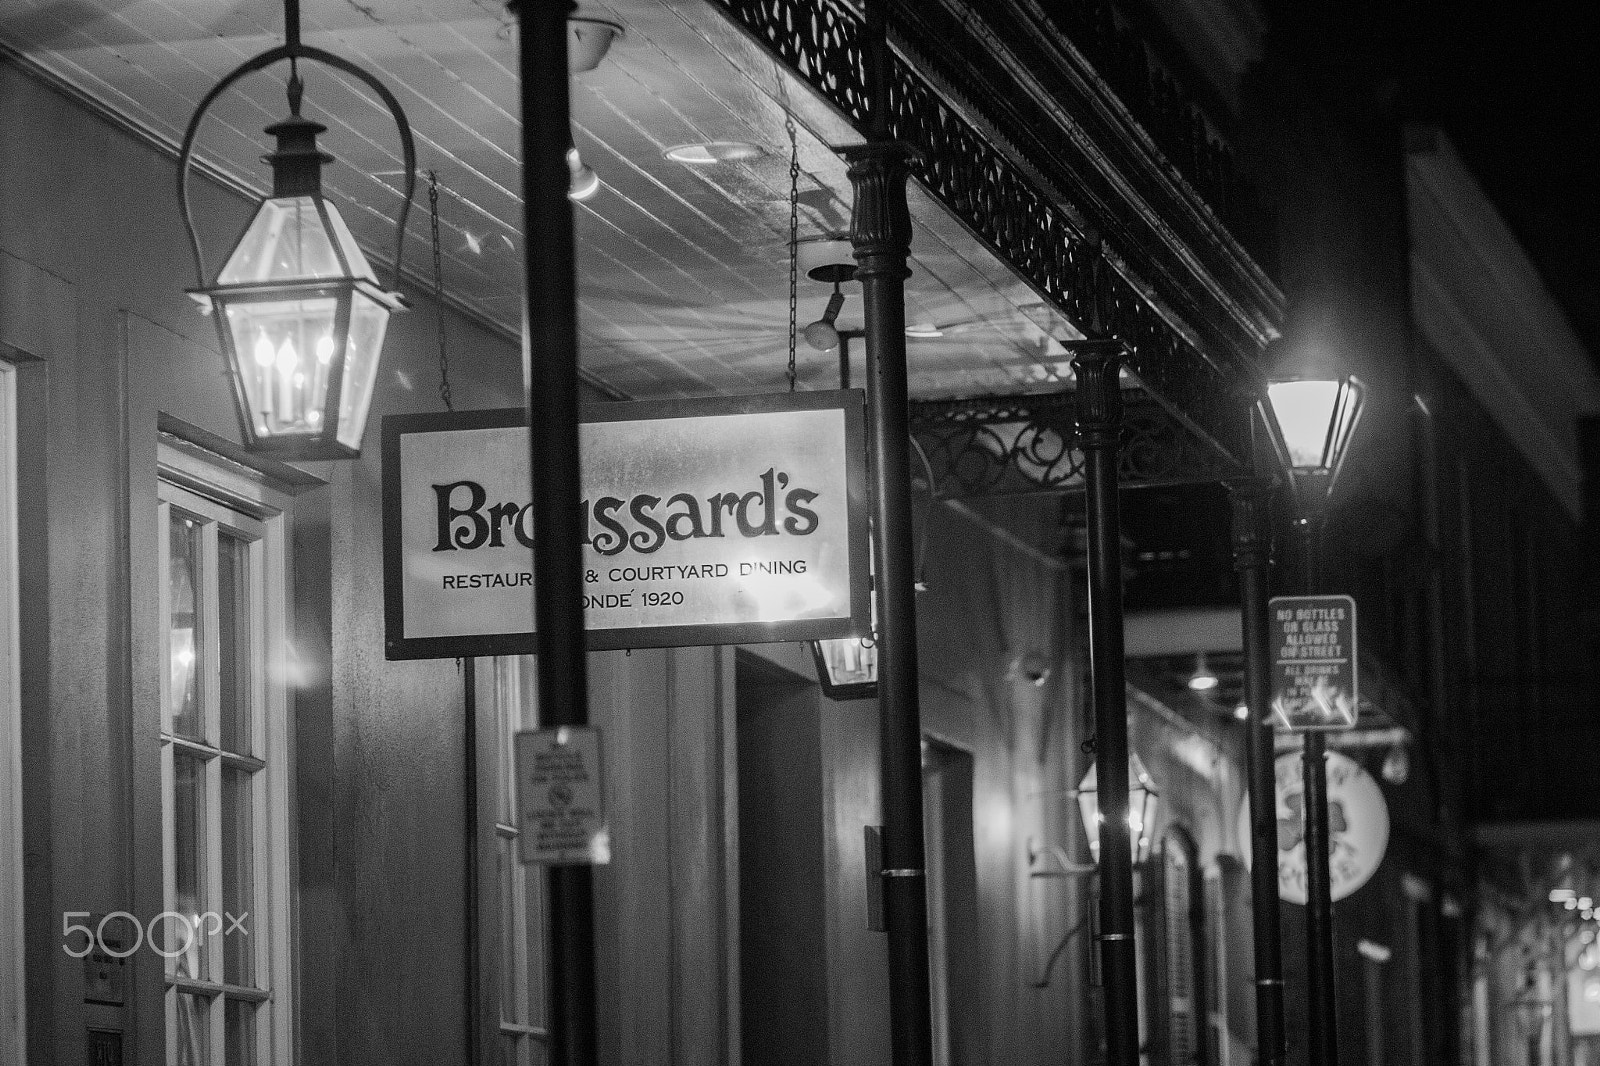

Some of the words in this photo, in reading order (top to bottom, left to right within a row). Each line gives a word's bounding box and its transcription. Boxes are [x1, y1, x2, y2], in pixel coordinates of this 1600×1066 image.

[431, 467, 820, 556] Brossard's
[443, 572, 533, 589] RESTAUR
[584, 569, 599, 583] &
[608, 563, 729, 582] COURTYARD
[642, 591, 684, 607] 1920
[1276, 609, 1293, 621] NO
[1296, 608, 1345, 621] BOTTLES
[1302, 621, 1339, 633] GLASS
[1286, 633, 1338, 645] ALLOWED
